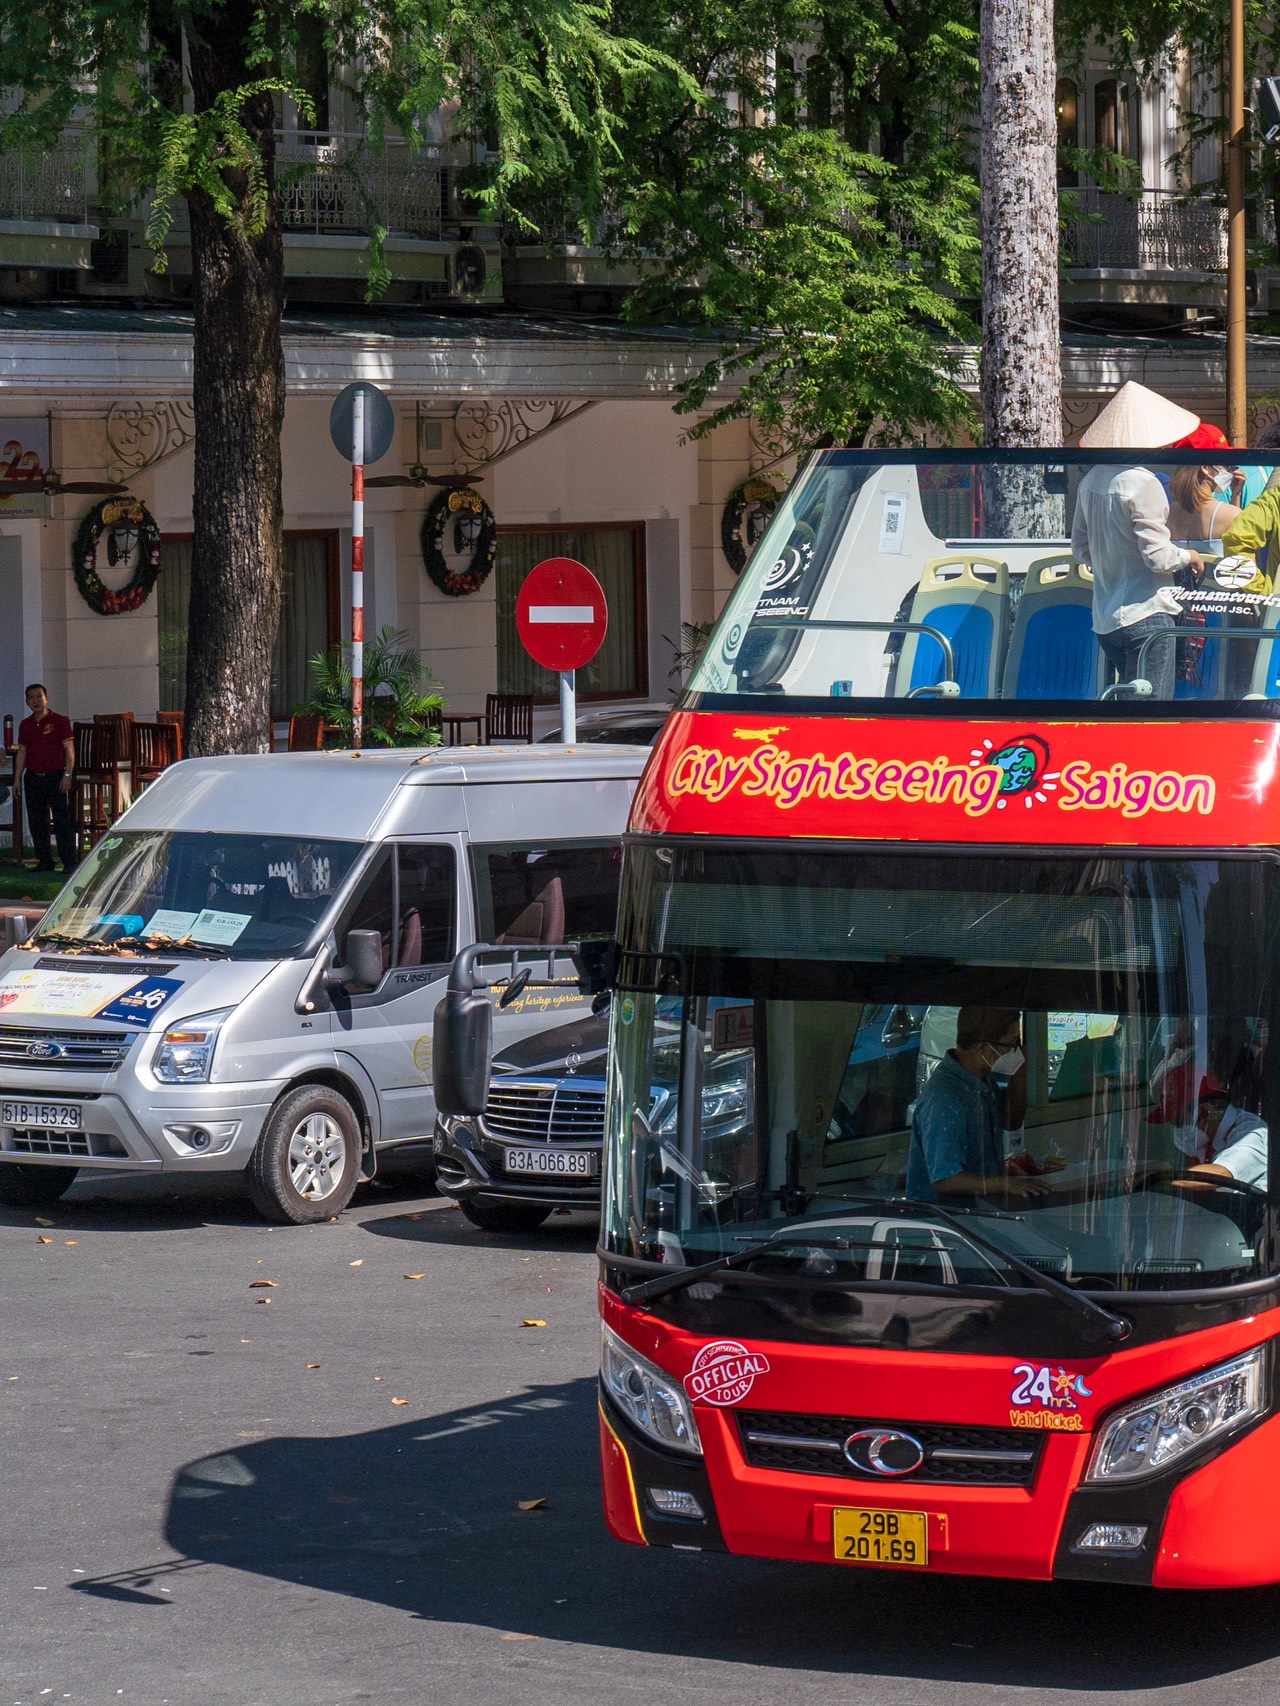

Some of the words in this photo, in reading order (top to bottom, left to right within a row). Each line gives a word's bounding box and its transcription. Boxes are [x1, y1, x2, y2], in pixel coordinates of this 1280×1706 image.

[1191, 604, 1227, 613] HANOI
[1228, 605, 1254, 615] JSC.
[1058, 760, 1217, 818] Saigon
[395, 973, 432, 983] TRANSIT
[526, 993, 552, 1012] heritage
[553, 994, 584, 1008] experience
[32, 1043, 54, 1055] Ford
[4, 1104, 78, 1126] 51B-153.29
[508, 1151, 586, 1172] 63A-066.89
[698, 1353, 710, 1368] CITY
[707, 1345, 743, 1357] SIGHTSEEING
[691, 1357, 764, 1394] OFFICIAL
[1011, 1365, 1053, 1406] 24
[716, 1380, 749, 1400] TOUR
[1010, 1409, 1042, 1429] Valid
[1042, 1410, 1083, 1431] Ticket
[859, 1512, 899, 1536] 29B
[844, 1535, 916, 1562] 201.69
